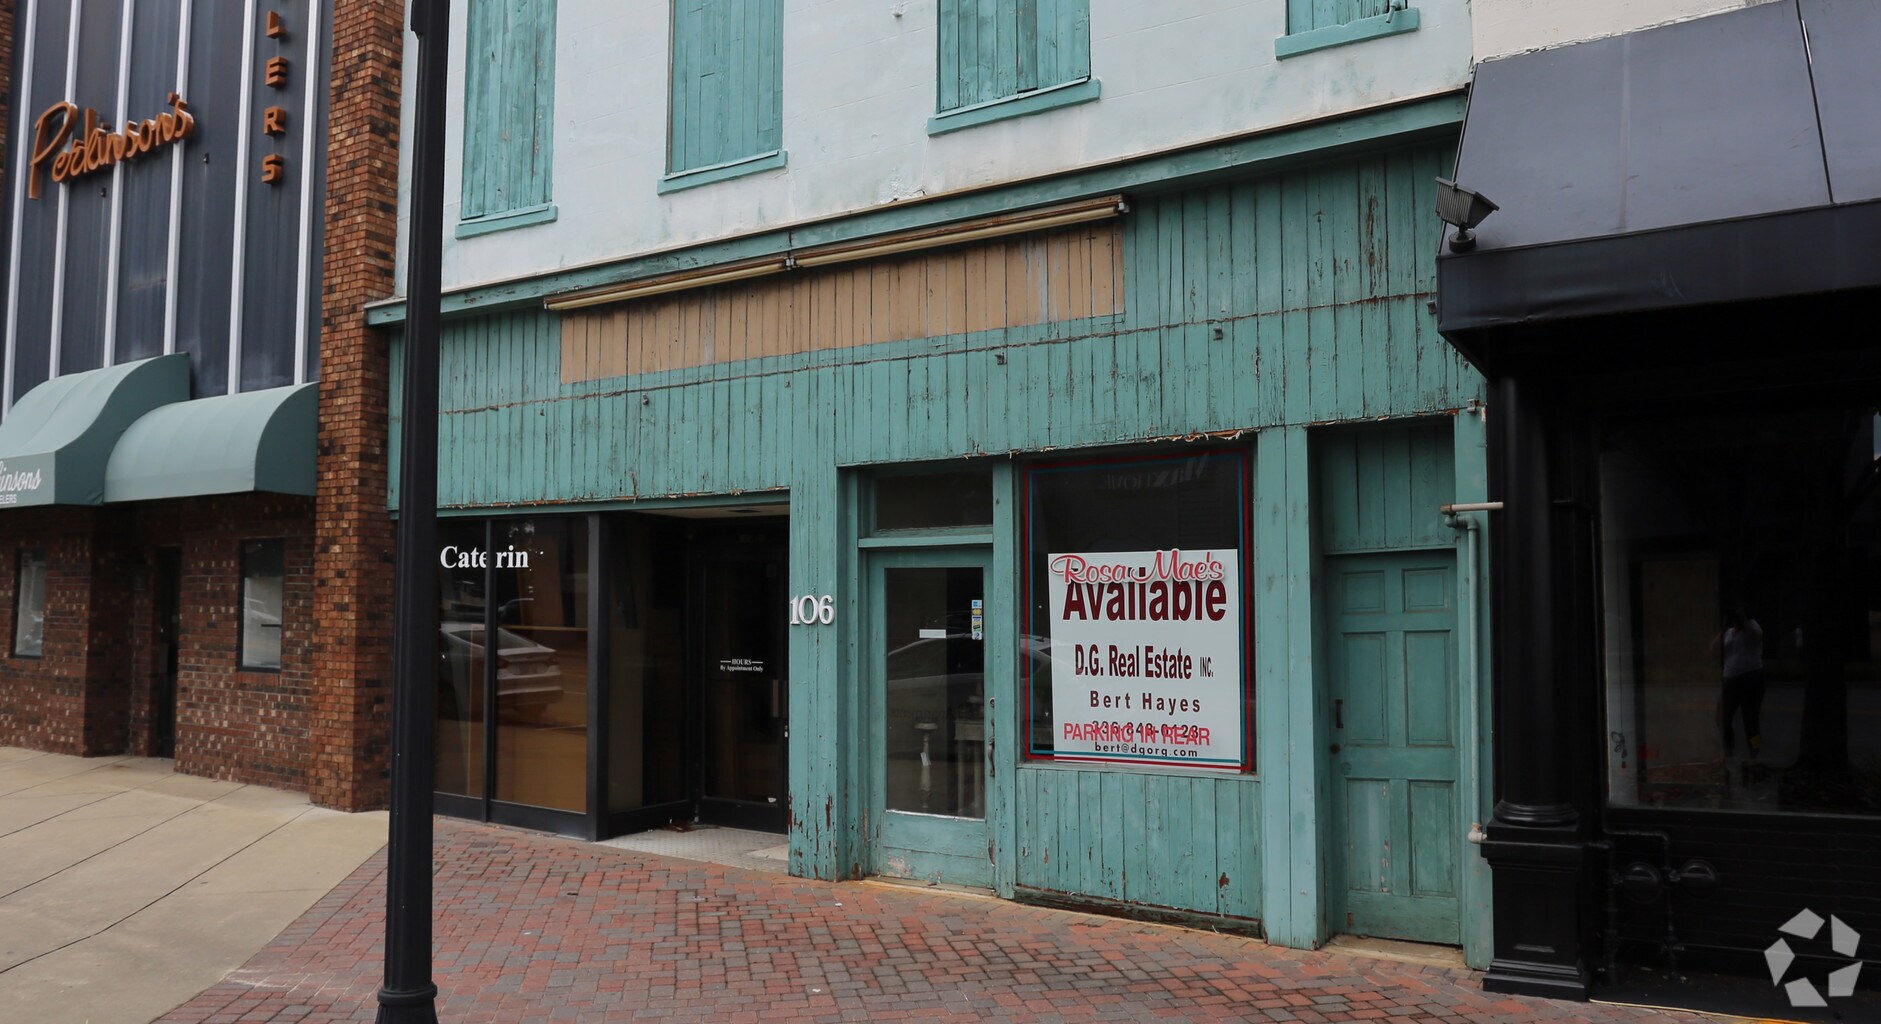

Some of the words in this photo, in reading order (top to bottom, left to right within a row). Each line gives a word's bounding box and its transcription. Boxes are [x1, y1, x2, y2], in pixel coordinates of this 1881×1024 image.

[28, 92, 194, 200] Perkinson's
[1050, 554, 1128, 584] Rosa
[1130, 549, 1224, 583] Mae's
[790, 595, 835, 625] 106
[1063, 567, 1227, 621] Available
[1075, 644, 1104, 677] D.G.
[1108, 645, 1140, 678] Real
[1145, 645, 1193, 680] Estate
[1090, 690, 1132, 709] Bert
[1142, 692, 1201, 716] Hayes
[1063, 722, 1135, 744] PARKING
[1140, 726, 1159, 744] IN
[1162, 727, 1212, 746] REAR
